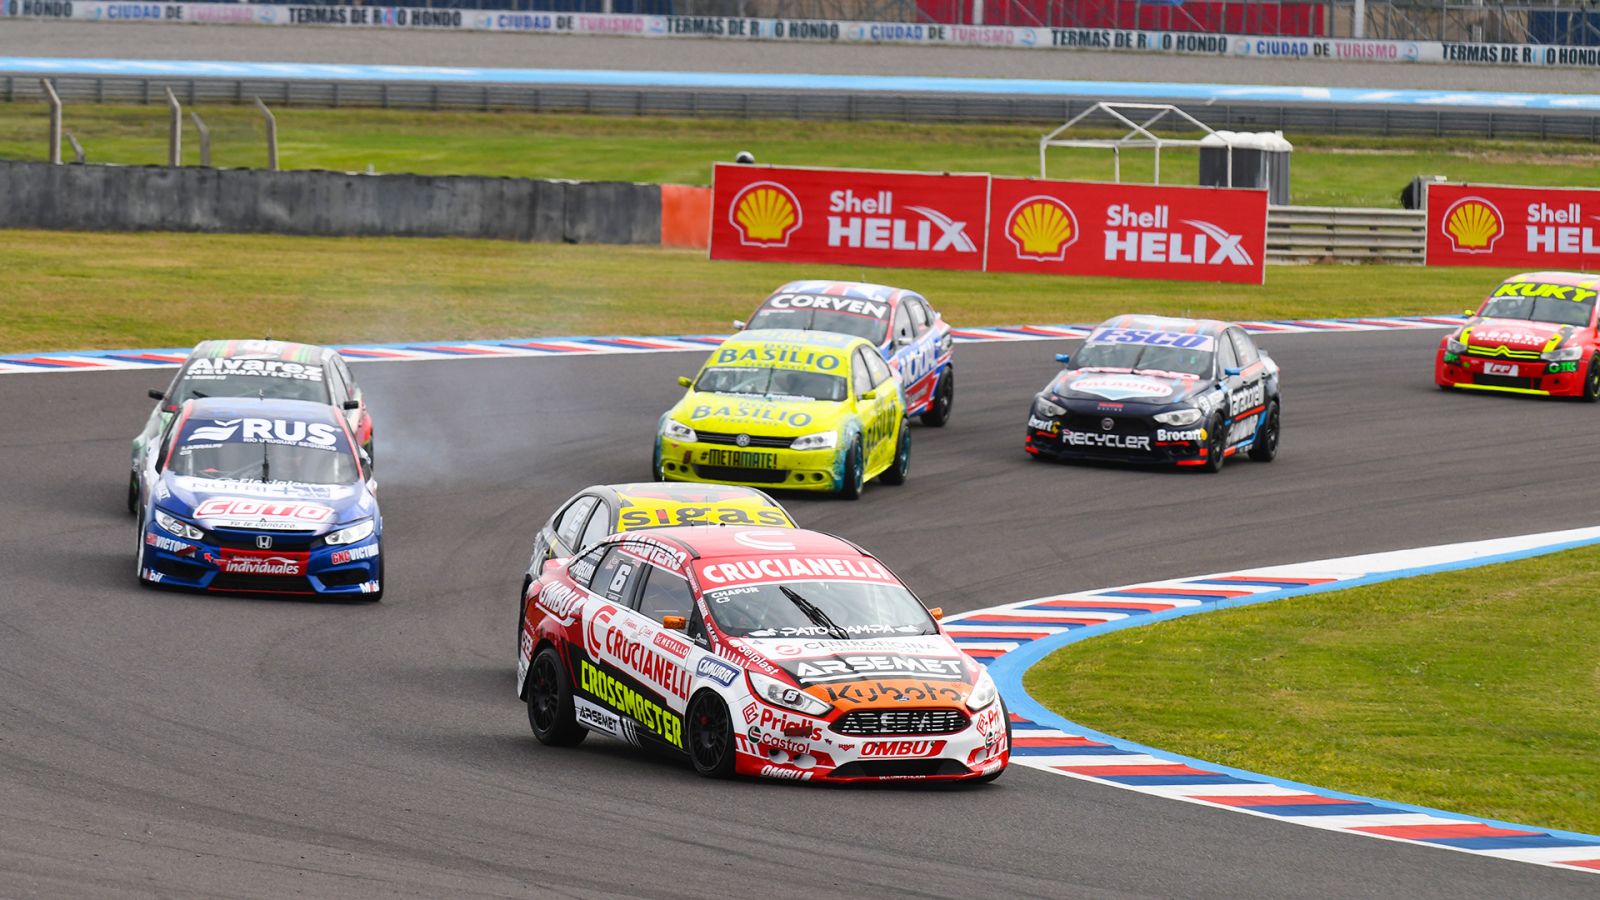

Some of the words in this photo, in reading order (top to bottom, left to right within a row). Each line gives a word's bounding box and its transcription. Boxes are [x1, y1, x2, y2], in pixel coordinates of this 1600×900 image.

[107, 5, 161, 19] CIUDAD
[165, 6, 183, 19] DE
[289, 8, 347, 24] TERMAS
[351, 9, 368, 25] DE
[411, 10, 462, 27] HONDO
[498, 15, 551, 29] CIUDAD
[556, 16, 574, 30] DE
[579, 16, 643, 32] TURISMO
[667, 18, 725, 35] TERMAS
[728, 19, 746, 35] DE
[789, 22, 840, 39] HONDO
[871, 25, 923, 40] CIUDAD
[928, 26, 945, 41] DE
[951, 28, 1014, 45] TURISMO
[1052, 29, 1110, 48] TERMAS
[1114, 31, 1133, 48] DE
[1176, 34, 1227, 53] HONDO
[1256, 39, 1309, 56] CIUDAD
[1313, 42, 1330, 57] DE
[1335, 43, 1397, 60] TURISMO
[1442, 44, 1498, 62] TERMAS
[1501, 47, 1519, 62] DE
[828, 189, 892, 216] Shell
[1527, 202, 1581, 224] Shell
[1105, 202, 1169, 230] Shell
[827, 207, 977, 252] HELIX
[1104, 220, 1254, 266] HELIX
[1494, 283, 1597, 302] KUKY
[770, 293, 888, 319] CORVEN
[1093, 329, 1209, 348] ESCO
[188, 357, 323, 376] Alvarez
[718, 348, 840, 370] BASILIO
[186, 370, 322, 381] NEUMATICOS
[691, 406, 812, 427] BASILIO
[243, 418, 336, 447] RUS
[700, 449, 777, 469] #METAMATE!
[197, 500, 331, 521] COTO
[622, 504, 787, 527] sigas
[226, 560, 300, 575] individuales
[608, 563, 632, 592] 6
[703, 557, 891, 583] CRUCIANELLI
[711, 586, 759, 599] CHAPUR
[663, 637, 690, 656] METALLO
[606, 625, 692, 702] CRUCIANELLI
[797, 654, 962, 676] ARSEMET
[783, 691, 800, 702] 6
[826, 682, 962, 704] Kubota
[581, 659, 683, 750] CROSSMASTER
[579, 705, 618, 733] ARSEMET
[762, 732, 811, 754] Castrol
[860, 740, 929, 756] OMBU
[761, 764, 801, 780] OMBU
